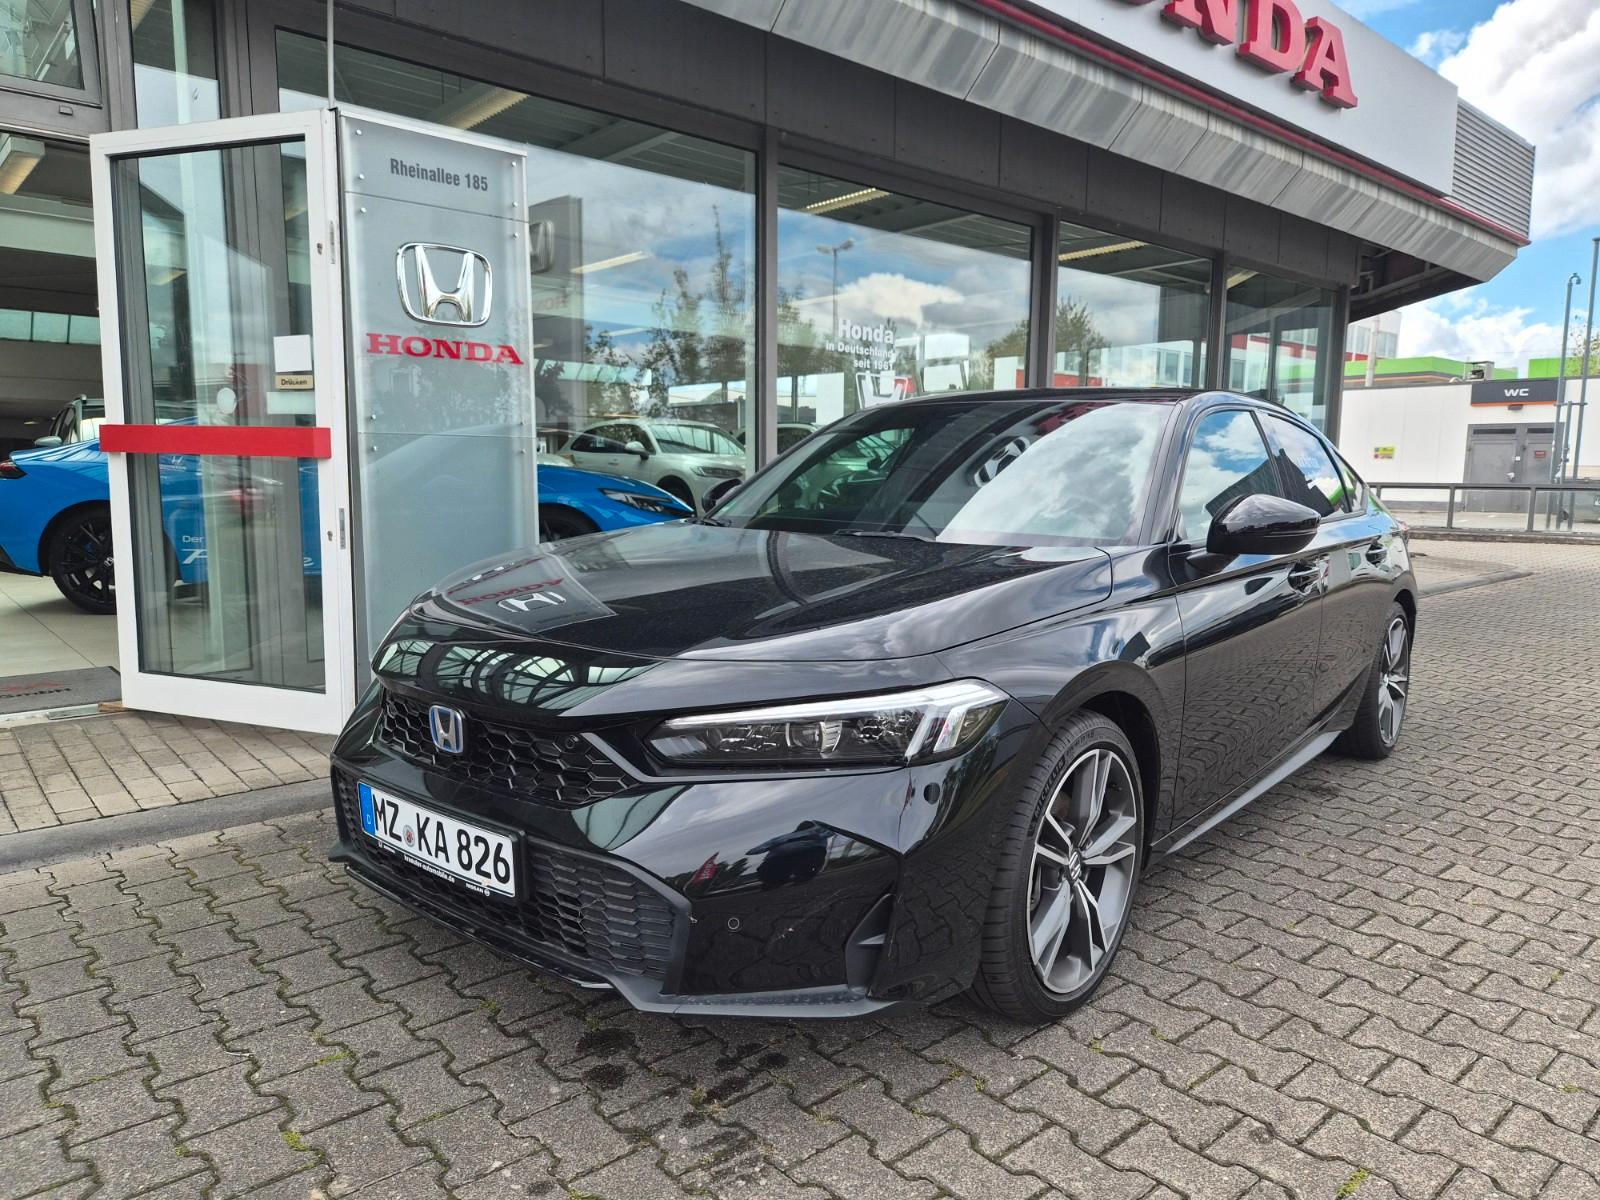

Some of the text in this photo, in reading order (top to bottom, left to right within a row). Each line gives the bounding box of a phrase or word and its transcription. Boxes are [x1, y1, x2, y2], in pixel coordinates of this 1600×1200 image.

[1107, 0, 1358, 109] NDA
[390, 158, 489, 192] Rheinallee 185
[838, 318, 894, 344] Honda
[366, 332, 524, 365] HONDA
[826, 341, 894, 358] in Deutschland
[853, 358, 870, 369] seit
[1504, 388, 1530, 397] WC
[182, 535, 205, 543] Der
[372, 794, 511, 885] MZ KA 826
